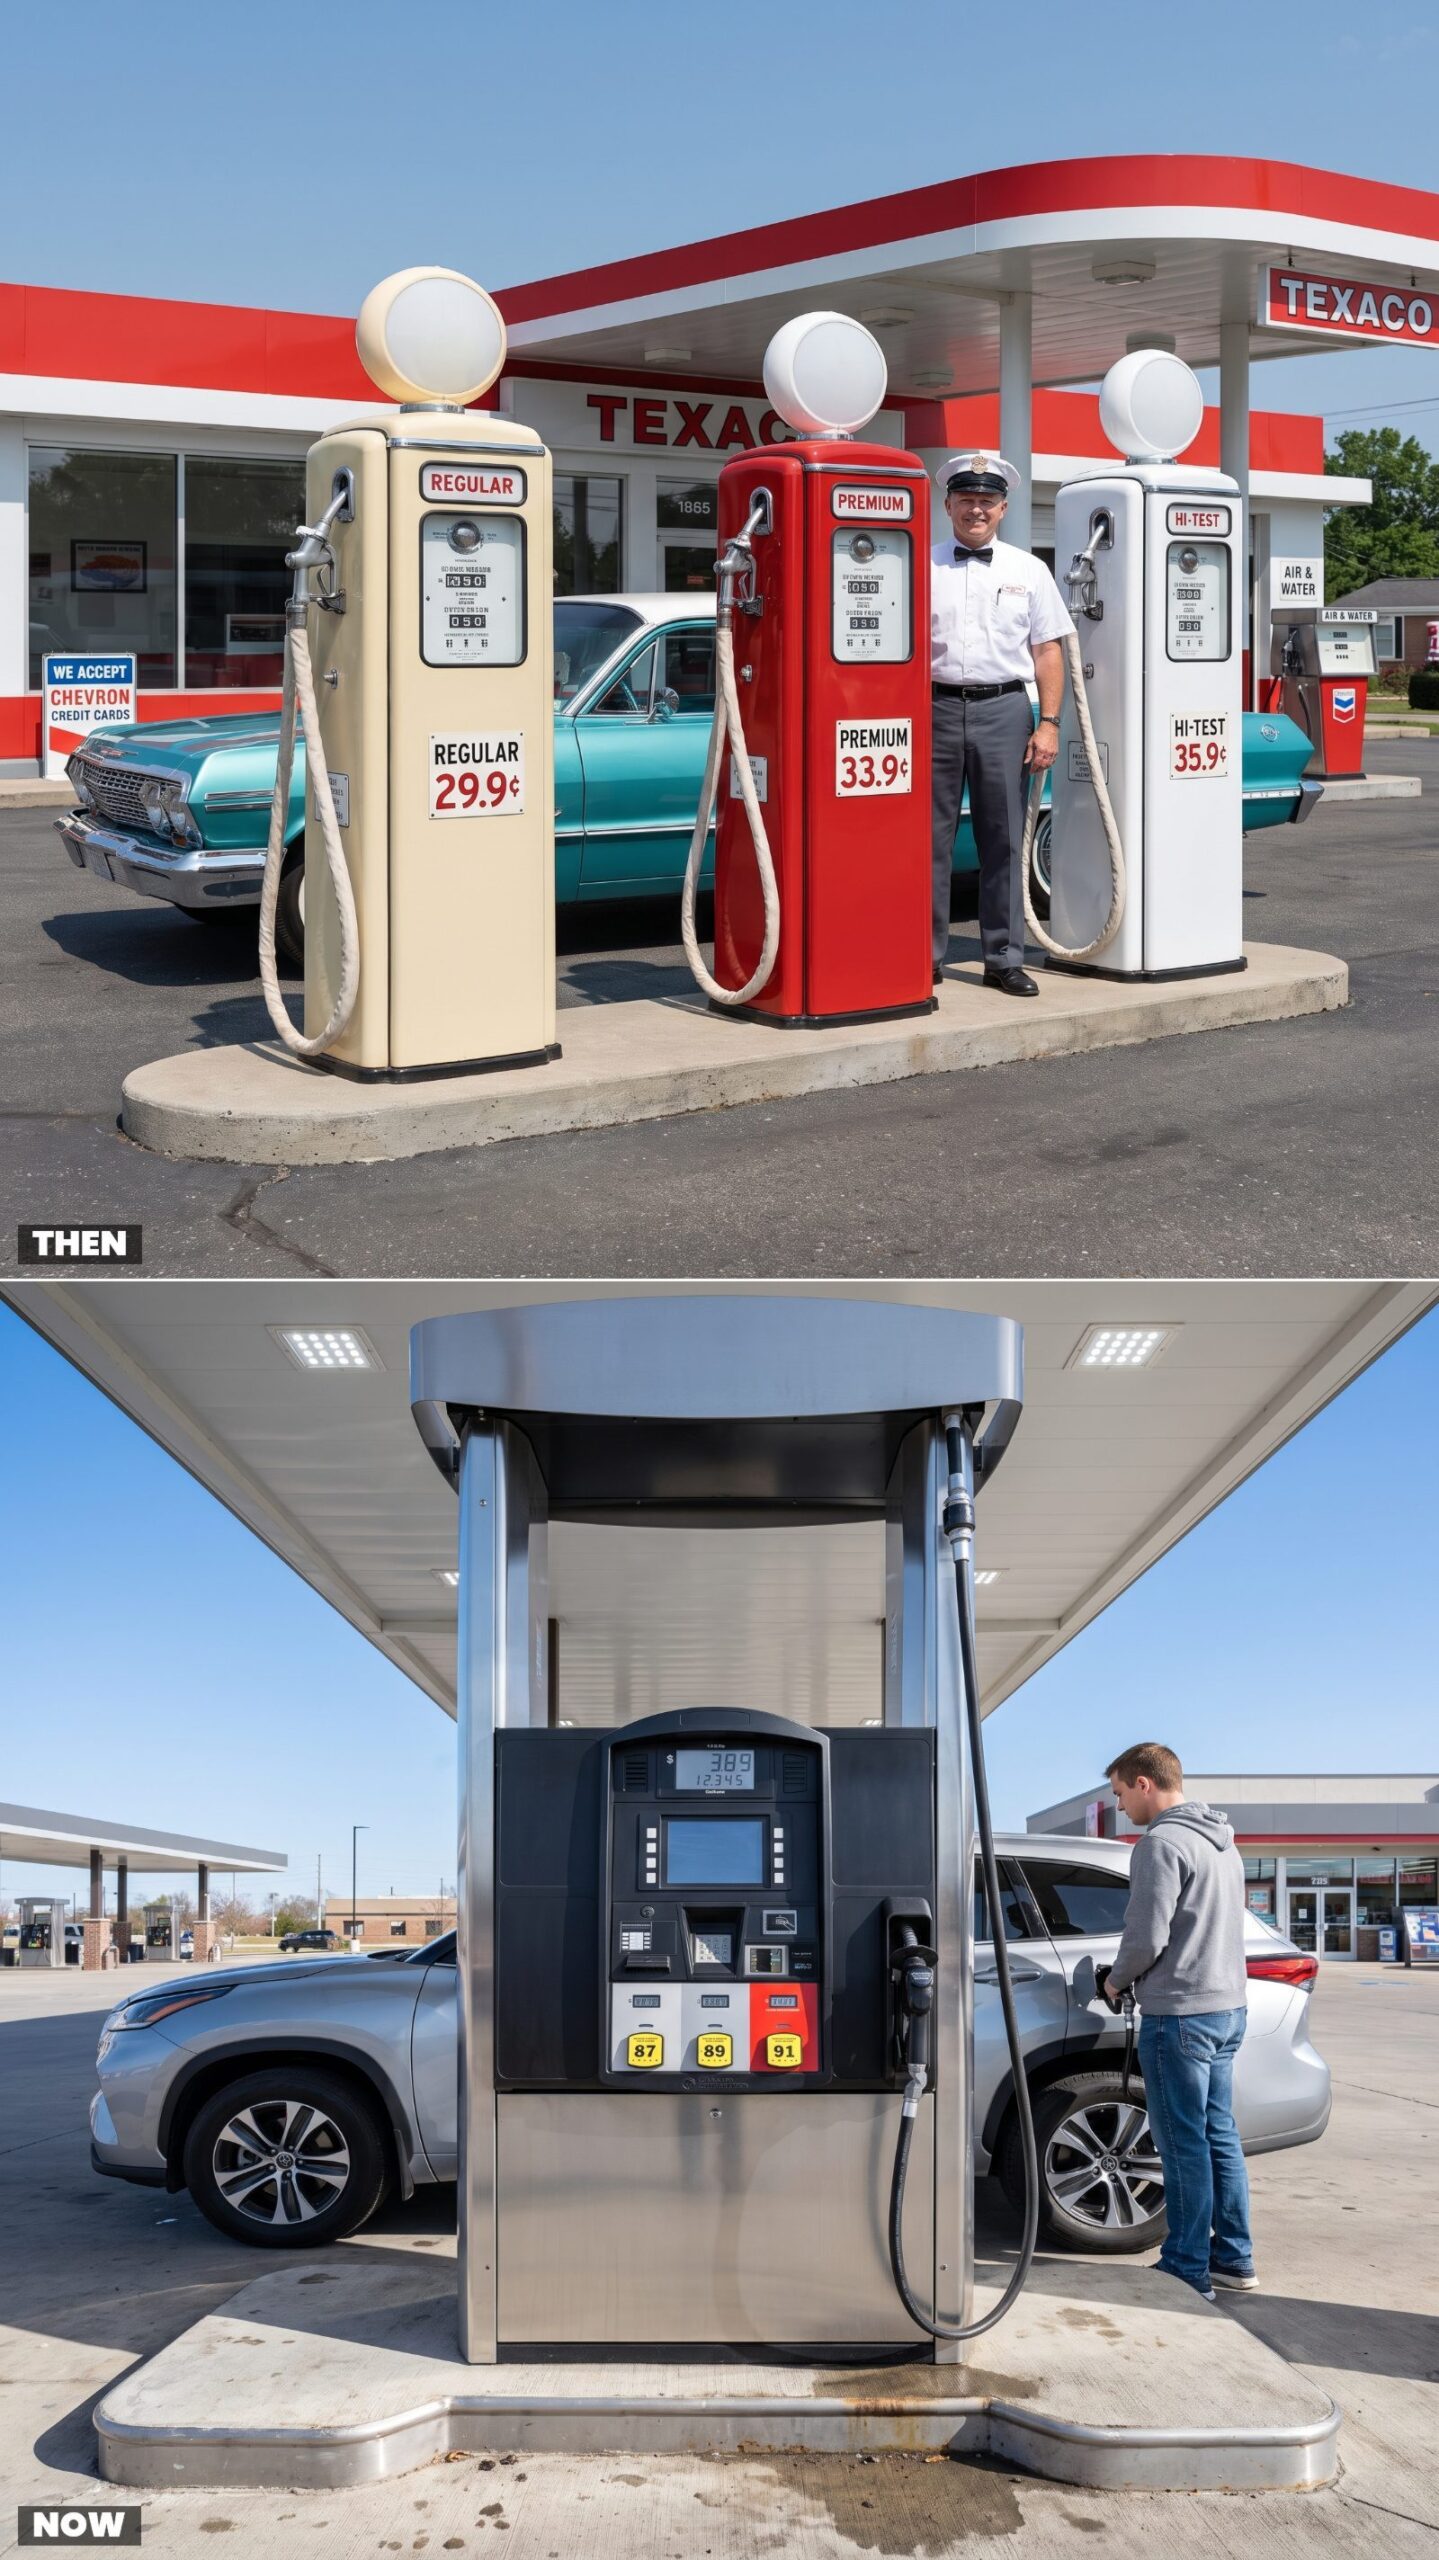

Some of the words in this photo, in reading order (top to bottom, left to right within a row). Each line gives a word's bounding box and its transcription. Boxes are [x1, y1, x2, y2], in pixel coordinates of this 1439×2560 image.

[1280, 277, 1433, 335] TEXACO
[587, 394, 796, 450] TEXAC
[431, 474, 513, 494] REGULAR
[678, 501, 711, 514] 1865
[838, 493, 904, 511] PREMIUM
[1175, 512, 1220, 527] HI-TEST
[1284, 566, 1302, 578] AIR
[1305, 566, 1312, 579] &
[1281, 583, 1316, 596] WATER
[1325, 611, 1338, 620] AIR
[1340, 611, 1345, 620] &
[1348, 612, 1373, 621] WATER
[53, 665, 74, 679] WE
[77, 665, 127, 679] ACCEPT
[51, 689, 130, 706] CHEVRON
[51, 710, 90, 721] CREDIT
[94, 709, 130, 720] CARDS
[1175, 718, 1226, 737] HI-TEST
[840, 728, 908, 749] PREMIUM
[434, 741, 519, 765] REGULAR
[1174, 742, 1227, 772] 35.9¢
[841, 754, 908, 789] 33.9¢
[435, 770, 520, 810] 29.9¢
[634, 2045, 656, 2057] 87
[703, 2045, 726, 2058] 89
[773, 2045, 795, 2058] 91
